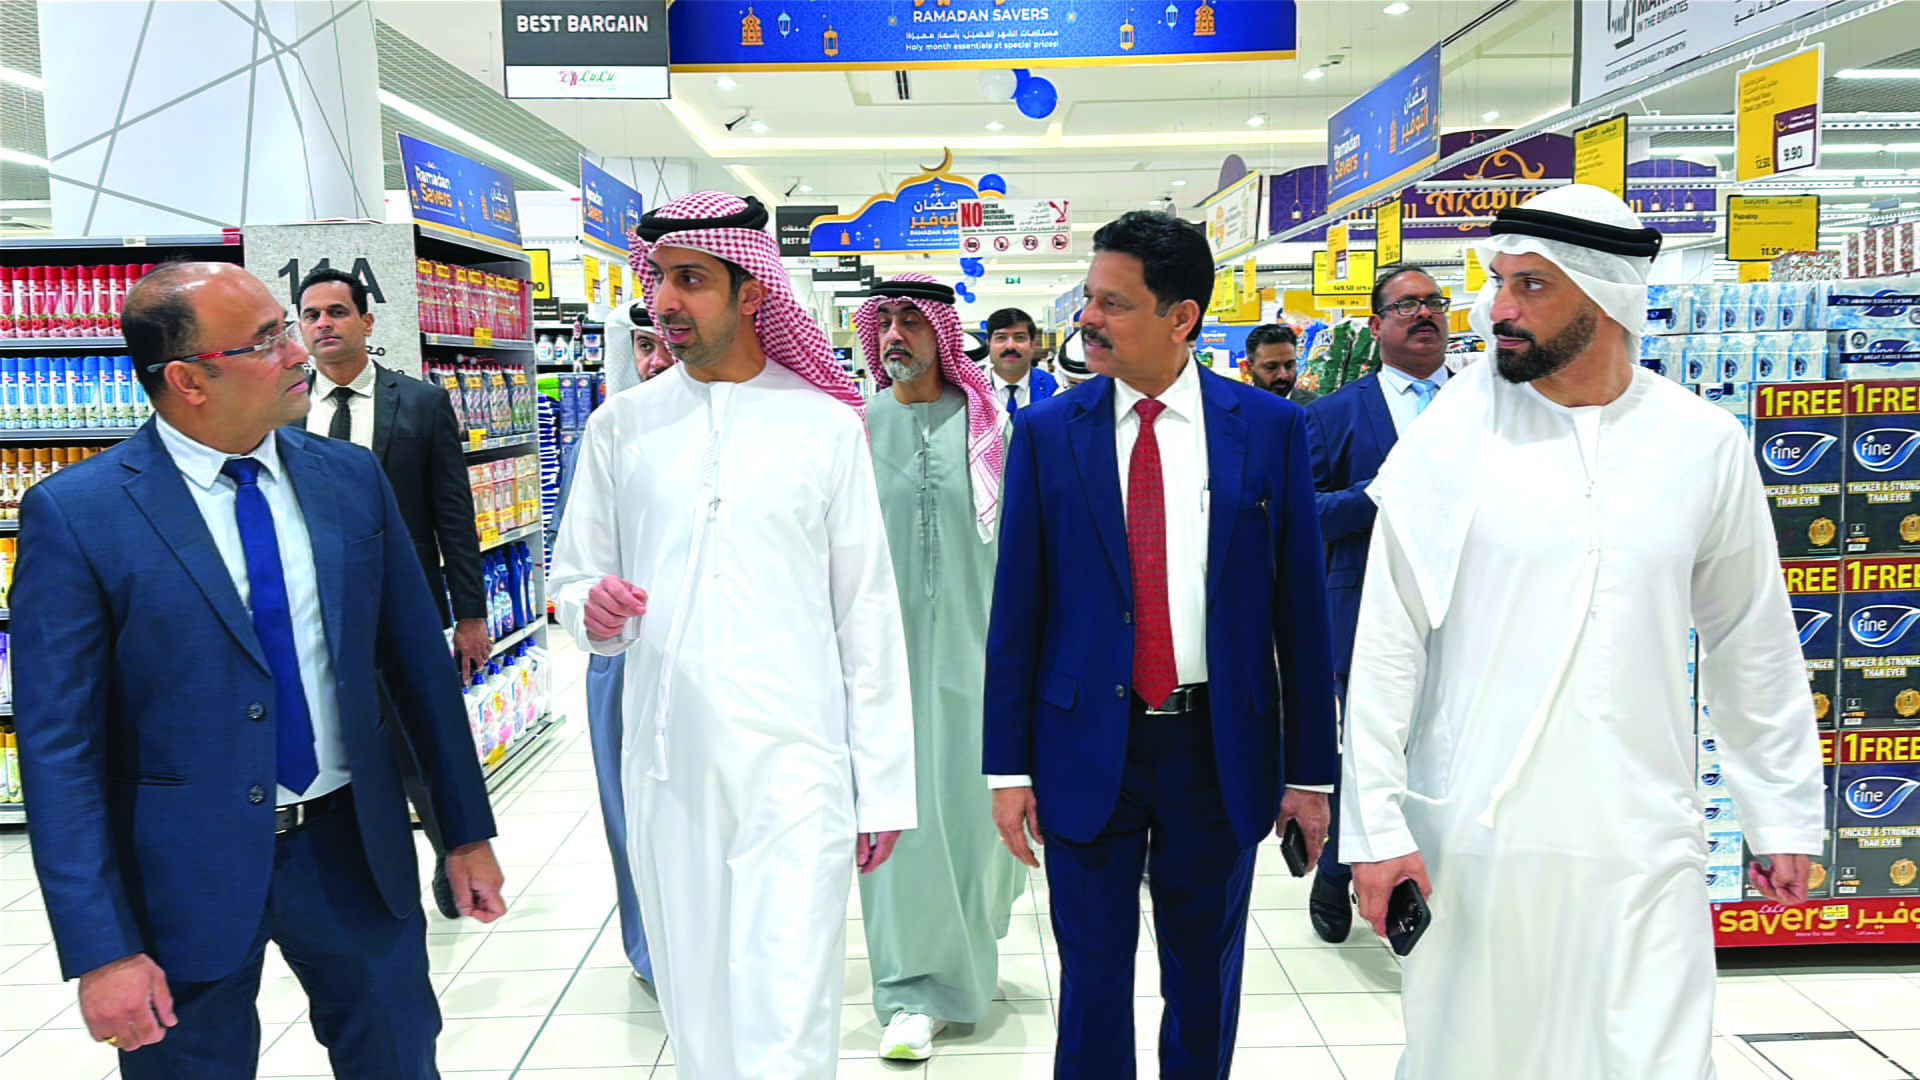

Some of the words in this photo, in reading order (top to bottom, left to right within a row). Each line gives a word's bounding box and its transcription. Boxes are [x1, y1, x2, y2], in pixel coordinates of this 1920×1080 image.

[913, 10, 988, 22] RAMADAN
[993, 8, 1049, 21] SAVERS
[1656, 1, 1689, 24] EMIRATES
[516, 15, 562, 32] BEST
[567, 15, 649, 32] BARGAIN
[906, 43, 923, 52] Holy
[926, 42, 952, 50] month
[954, 42, 992, 50] essentials
[1004, 40, 1032, 50] special
[1404, 85, 1428, 116] رمضان
[1401, 102, 1429, 146] التوفير
[1333, 133, 1360, 161] Ramadan
[1784, 145, 1803, 161] 9.90
[1335, 153, 1358, 181] Savers
[414, 164, 452, 191] Ramadan
[420, 183, 453, 208] Savers
[587, 200, 603, 224] Savers
[914, 199, 958, 213] مضان
[961, 202, 983, 228] NO
[1048, 200, 1069, 223] لا
[781, 237, 800, 245] BEST
[1771, 438, 1801, 460] fine
[1862, 434, 1892, 456] fine
[1766, 486, 1790, 495] ICKER
[1792, 485, 1798, 494] &
[1800, 483, 1839, 494] STRONGER
[1849, 483, 1880, 493] THICKER
[1883, 482, 1889, 491] &
[1891, 481, 1920, 491] STRONG
[1777, 497, 1797, 506] THAN
[1800, 495, 1820, 505] EVER
[1869, 493, 1888, 502] THAN
[1891, 492, 1911, 501] EVER
[1857, 611, 1888, 632] fine
[1846, 658, 1876, 667] THICKER
[1879, 658, 1884, 666] &
[1887, 656, 1920, 666] STRONGE
[1865, 669, 1884, 677] THAN
[1887, 668, 1907, 677] EVER
[1854, 783, 1884, 803] fine
[1841, 829, 1871, 837] THICKER
[1874, 828, 1880, 836] &
[1861, 838, 1879, 847] THAN
[1882, 837, 1901, 846] EVER
[1758, 904, 1786, 913] LuLu
[1718, 907, 1838, 935] savers
